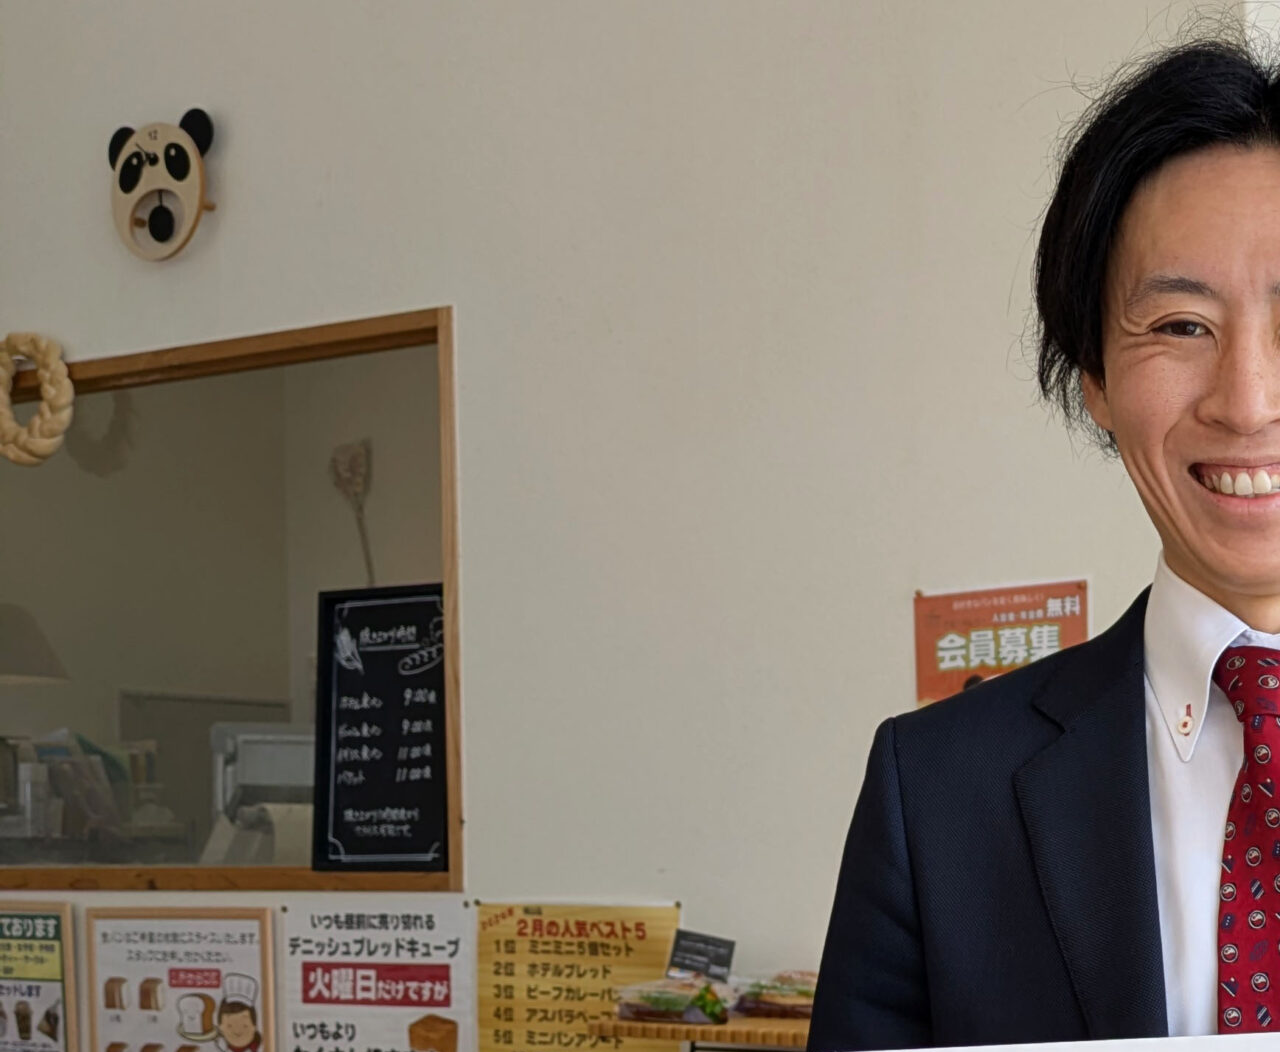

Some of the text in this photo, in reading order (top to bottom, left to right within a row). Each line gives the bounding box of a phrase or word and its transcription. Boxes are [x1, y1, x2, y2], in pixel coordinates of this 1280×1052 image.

[1047, 595, 1081, 618] 無料
[937, 624, 1061, 670] 会員募集
[310, 913, 435, 931] いつも昼前に売り切れる
[516, 918, 647, 940] 2月の人気ベスト5
[289, 937, 461, 958] デニッシュブレッドキューブ
[494, 939, 634, 957] 1位 ミニミニ5個セット
[493, 962, 613, 980] 2位 ホテルブレッド
[308, 968, 449, 1001] 火曜日だけですが
[493, 984, 514, 999] 3位
[493, 1007, 514, 1022] 4位
[293, 1022, 356, 1041] いつもより
[493, 1029, 513, 1044] 5位
